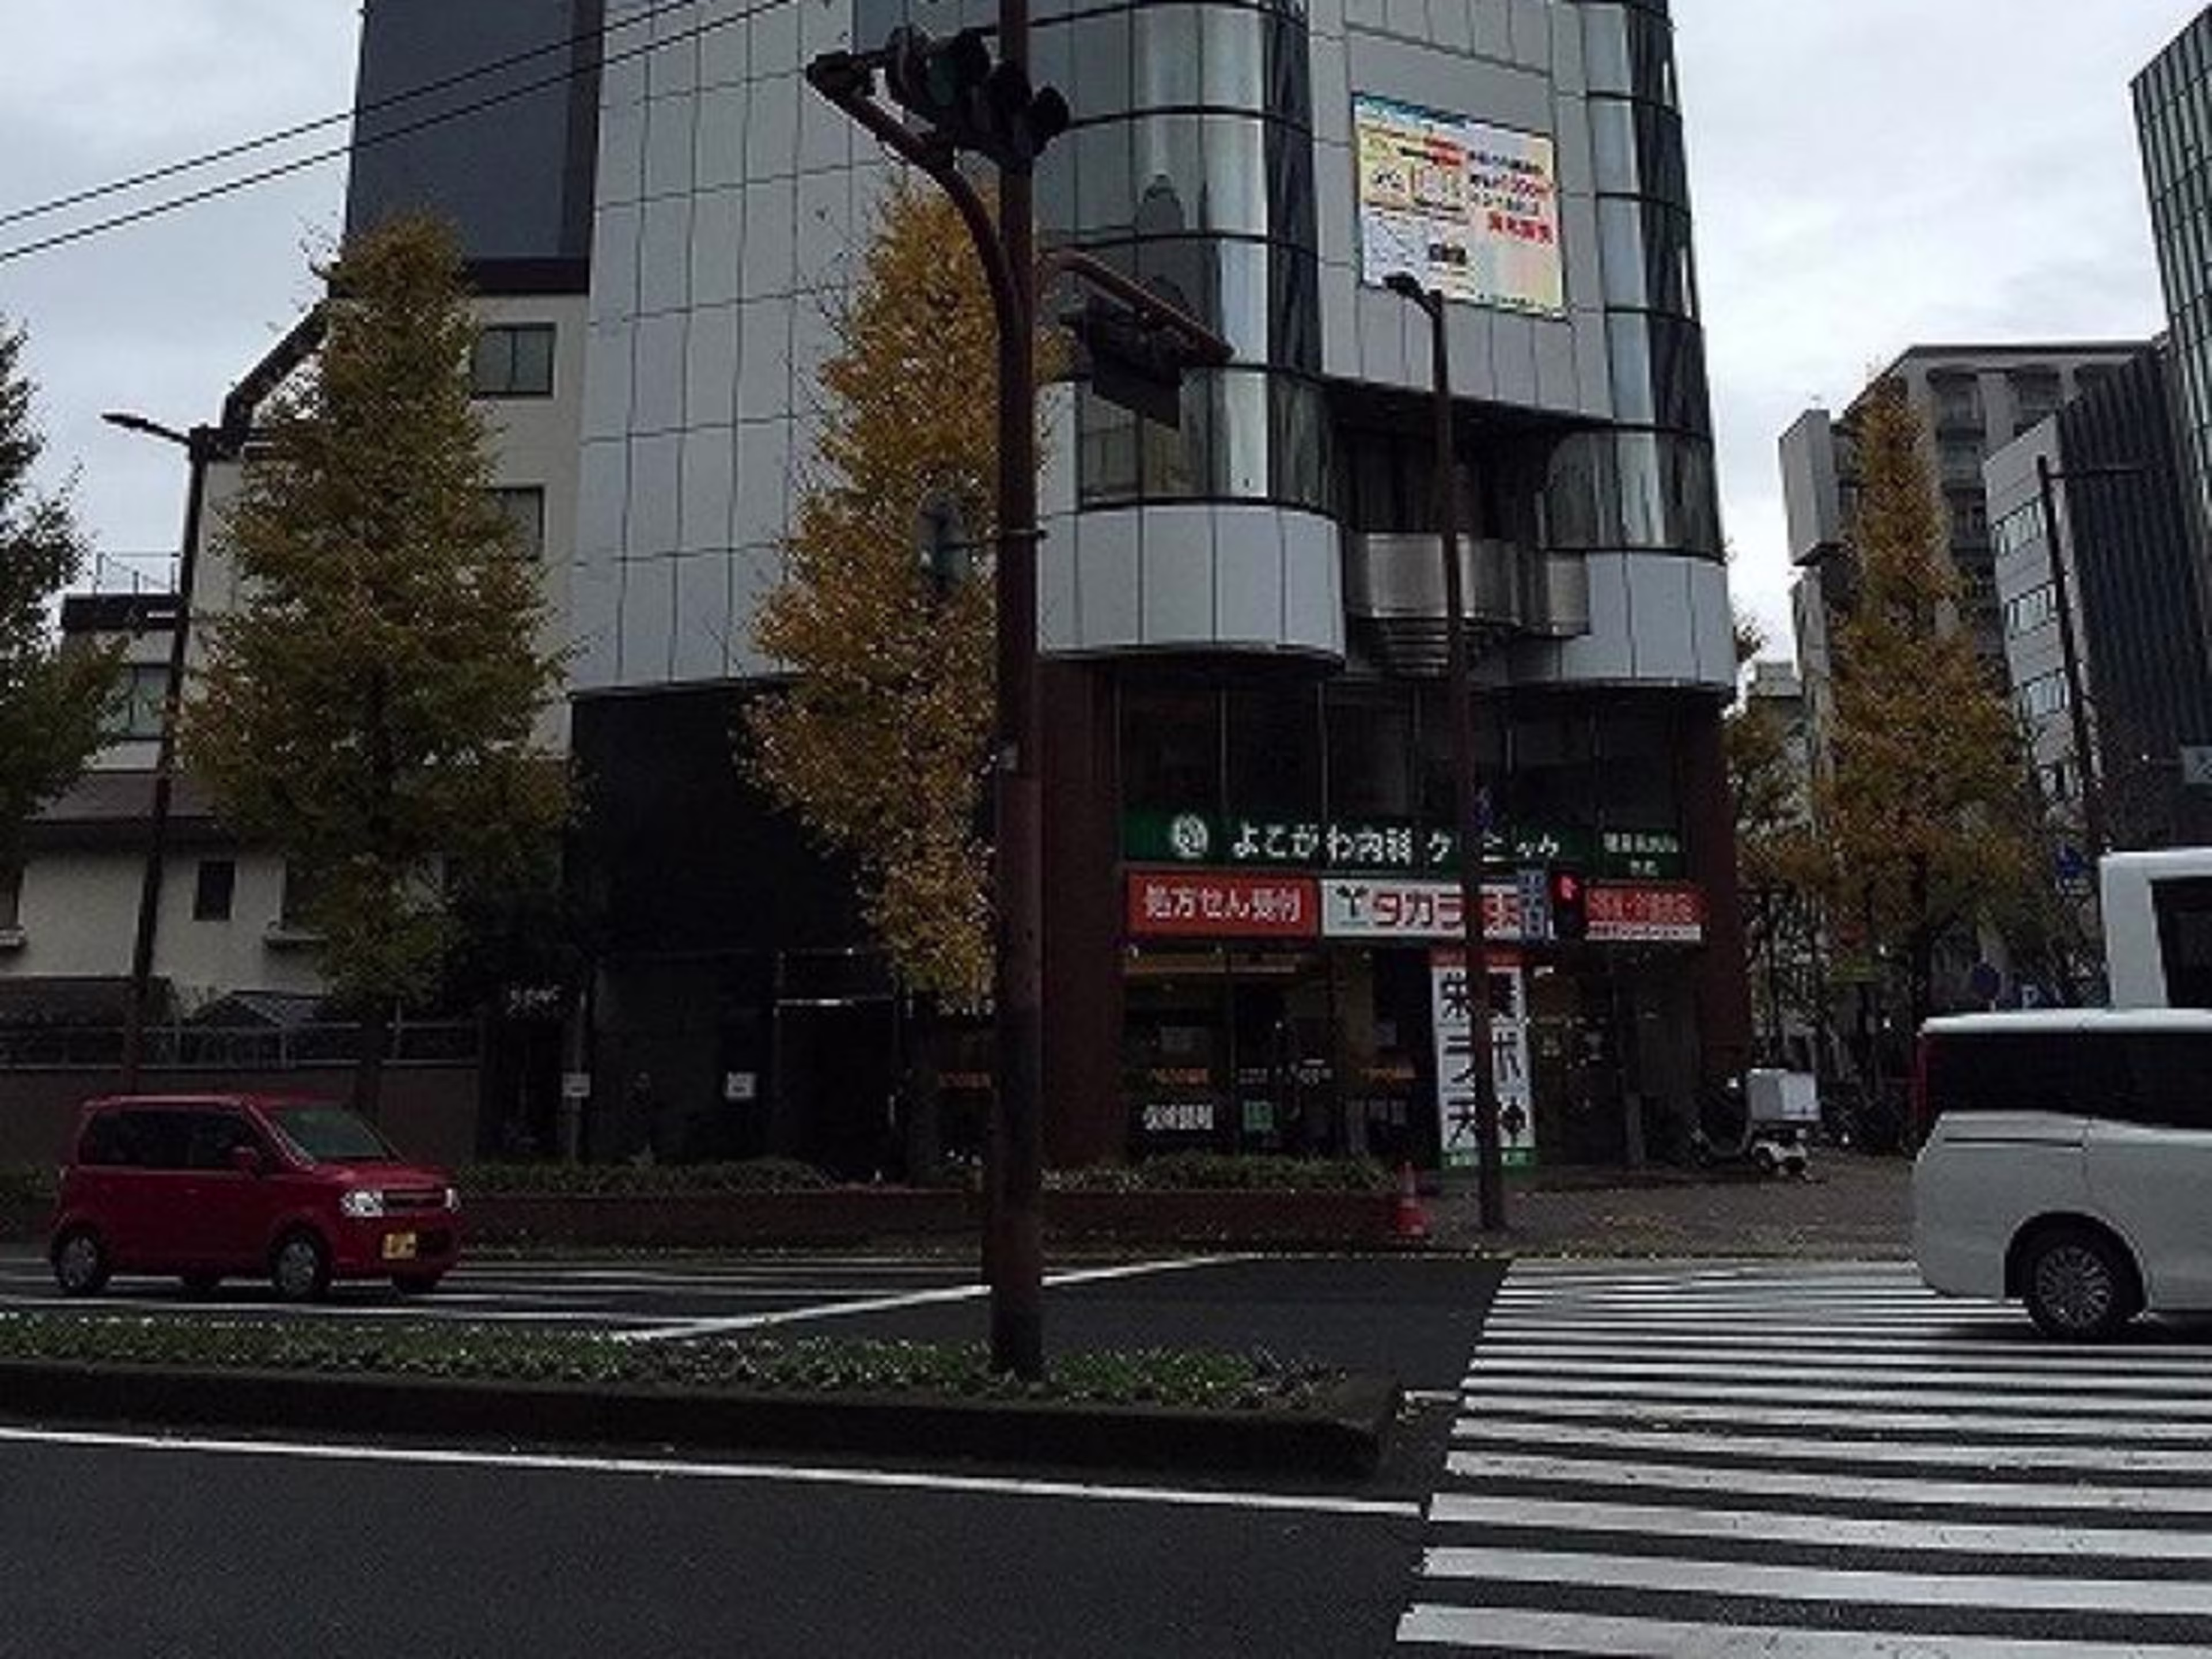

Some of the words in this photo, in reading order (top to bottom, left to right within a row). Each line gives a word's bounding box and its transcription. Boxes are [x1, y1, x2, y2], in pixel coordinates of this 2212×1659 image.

[1232, 819, 1561, 864] よこがわ内科クニック
[1143, 884, 1302, 923] 処方せん受付
